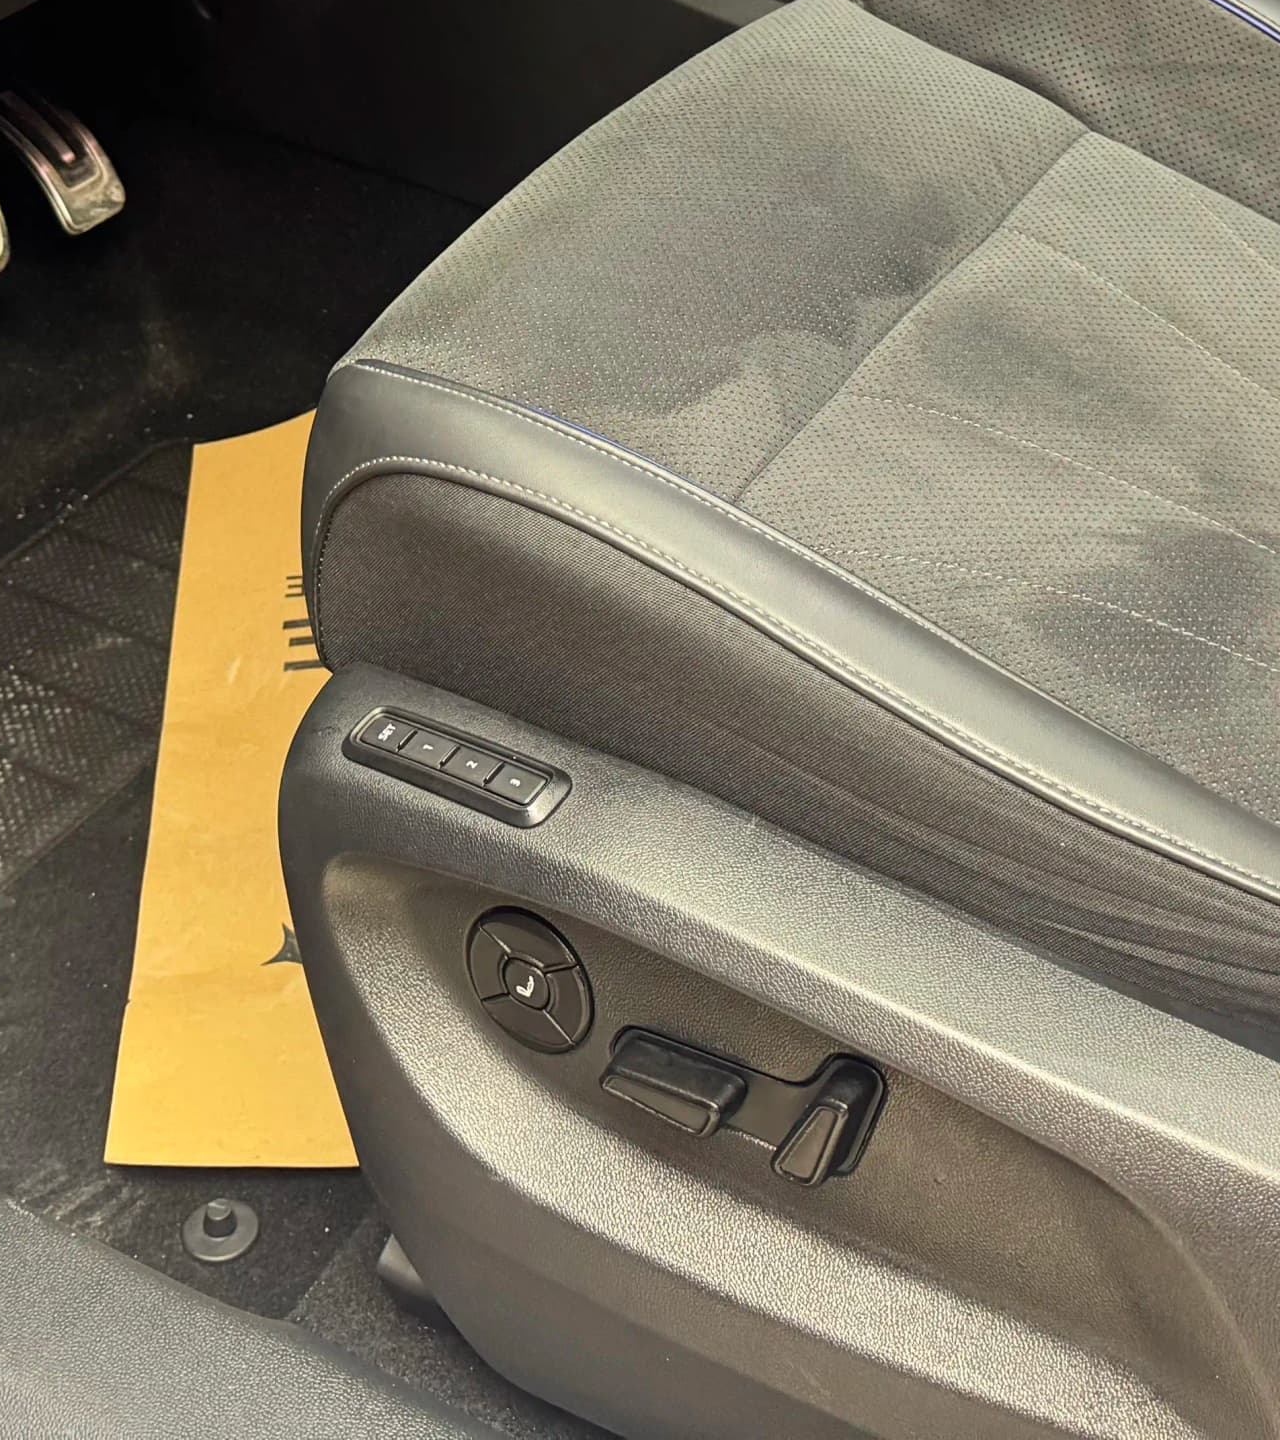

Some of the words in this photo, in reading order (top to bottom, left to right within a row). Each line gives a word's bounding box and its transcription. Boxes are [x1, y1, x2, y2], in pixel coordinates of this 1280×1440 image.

[378, 723, 396, 741] SET
[466, 761, 478, 769] 2
[510, 778, 521, 787] 3
